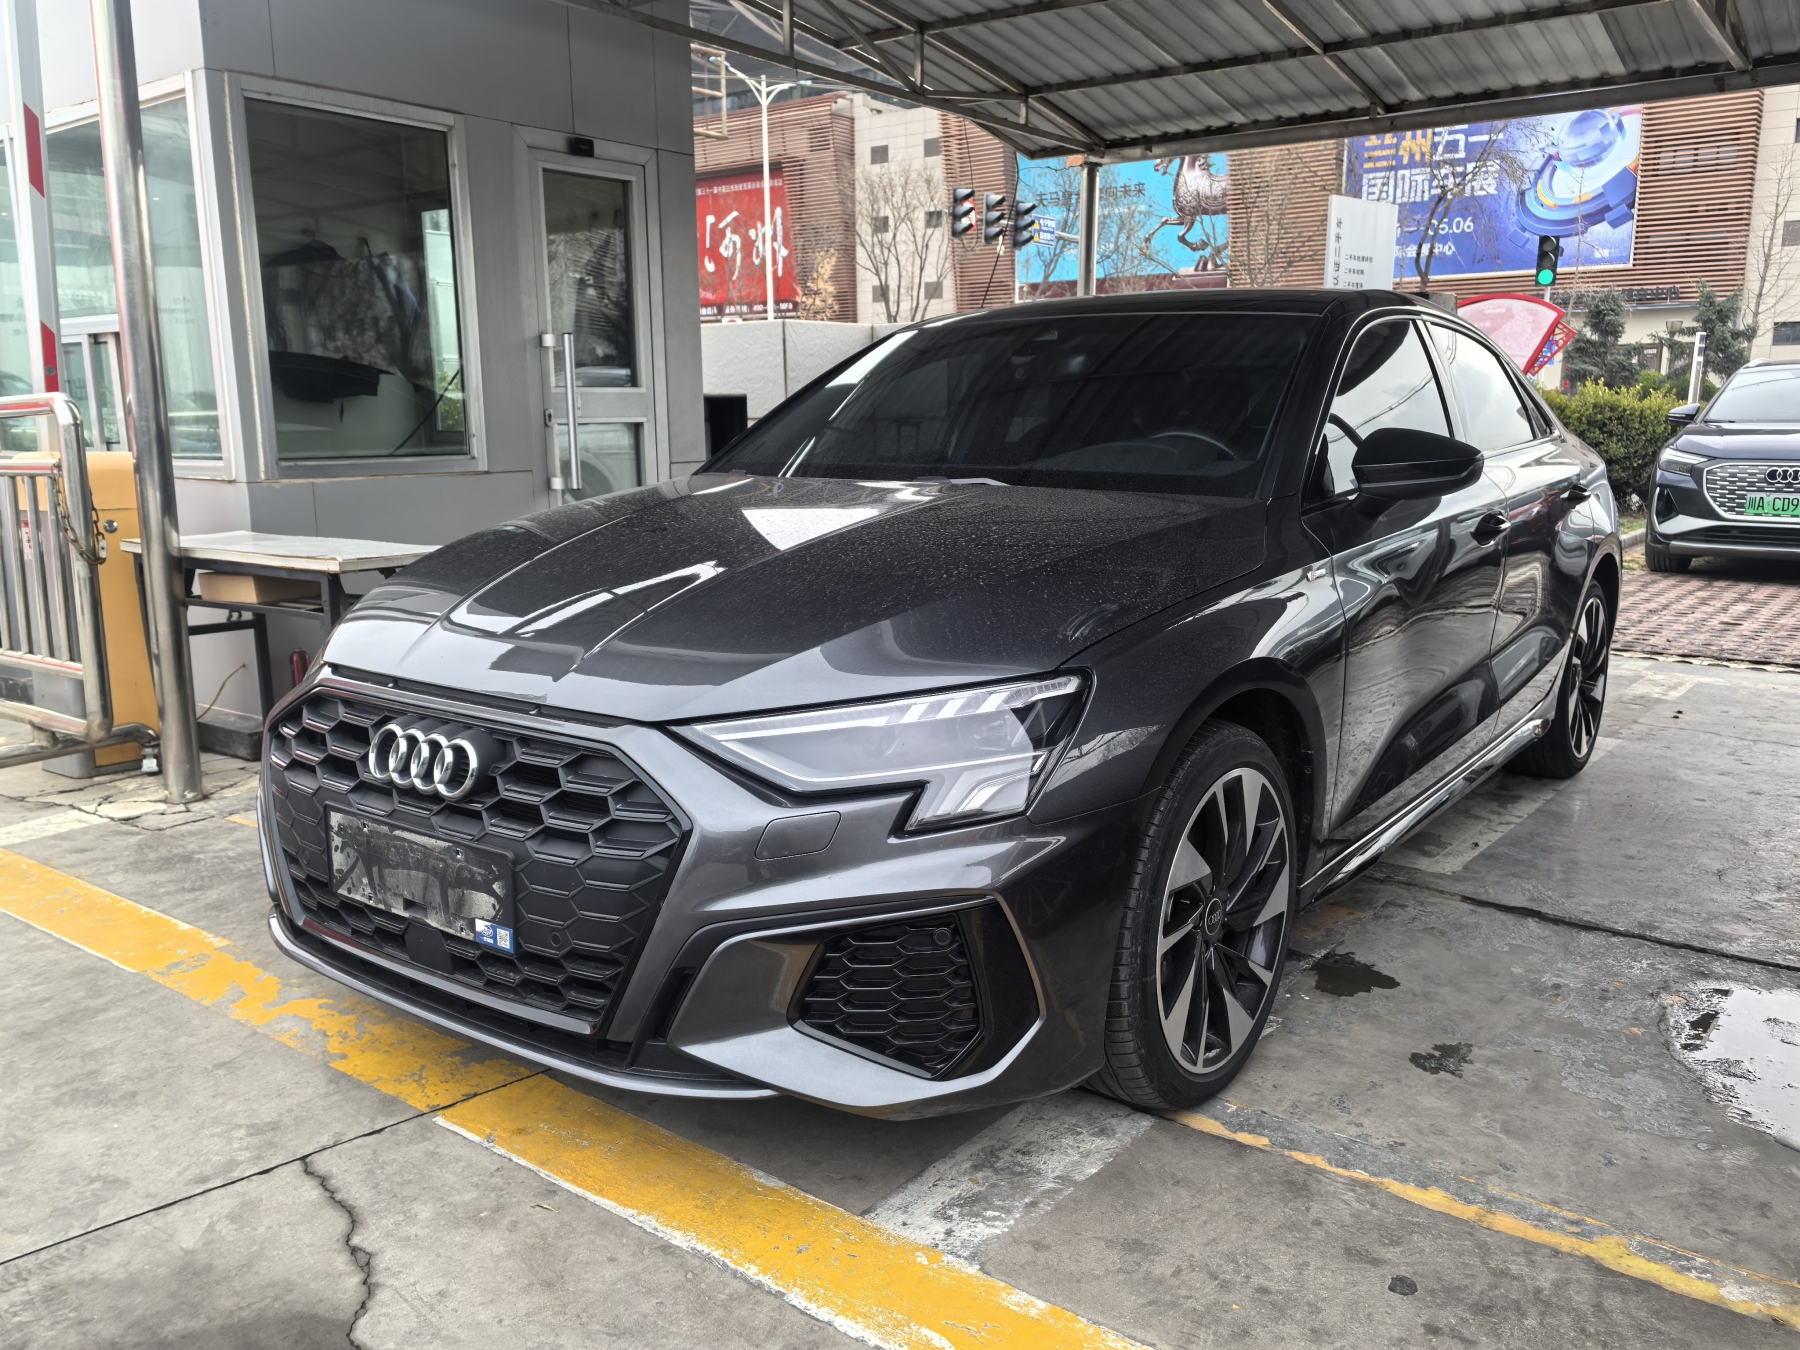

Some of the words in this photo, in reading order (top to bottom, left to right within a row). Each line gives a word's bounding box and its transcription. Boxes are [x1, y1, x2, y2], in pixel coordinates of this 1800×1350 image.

[1363, 124, 1504, 169] 兰州五一
[1362, 159, 1501, 204] 国际车展
